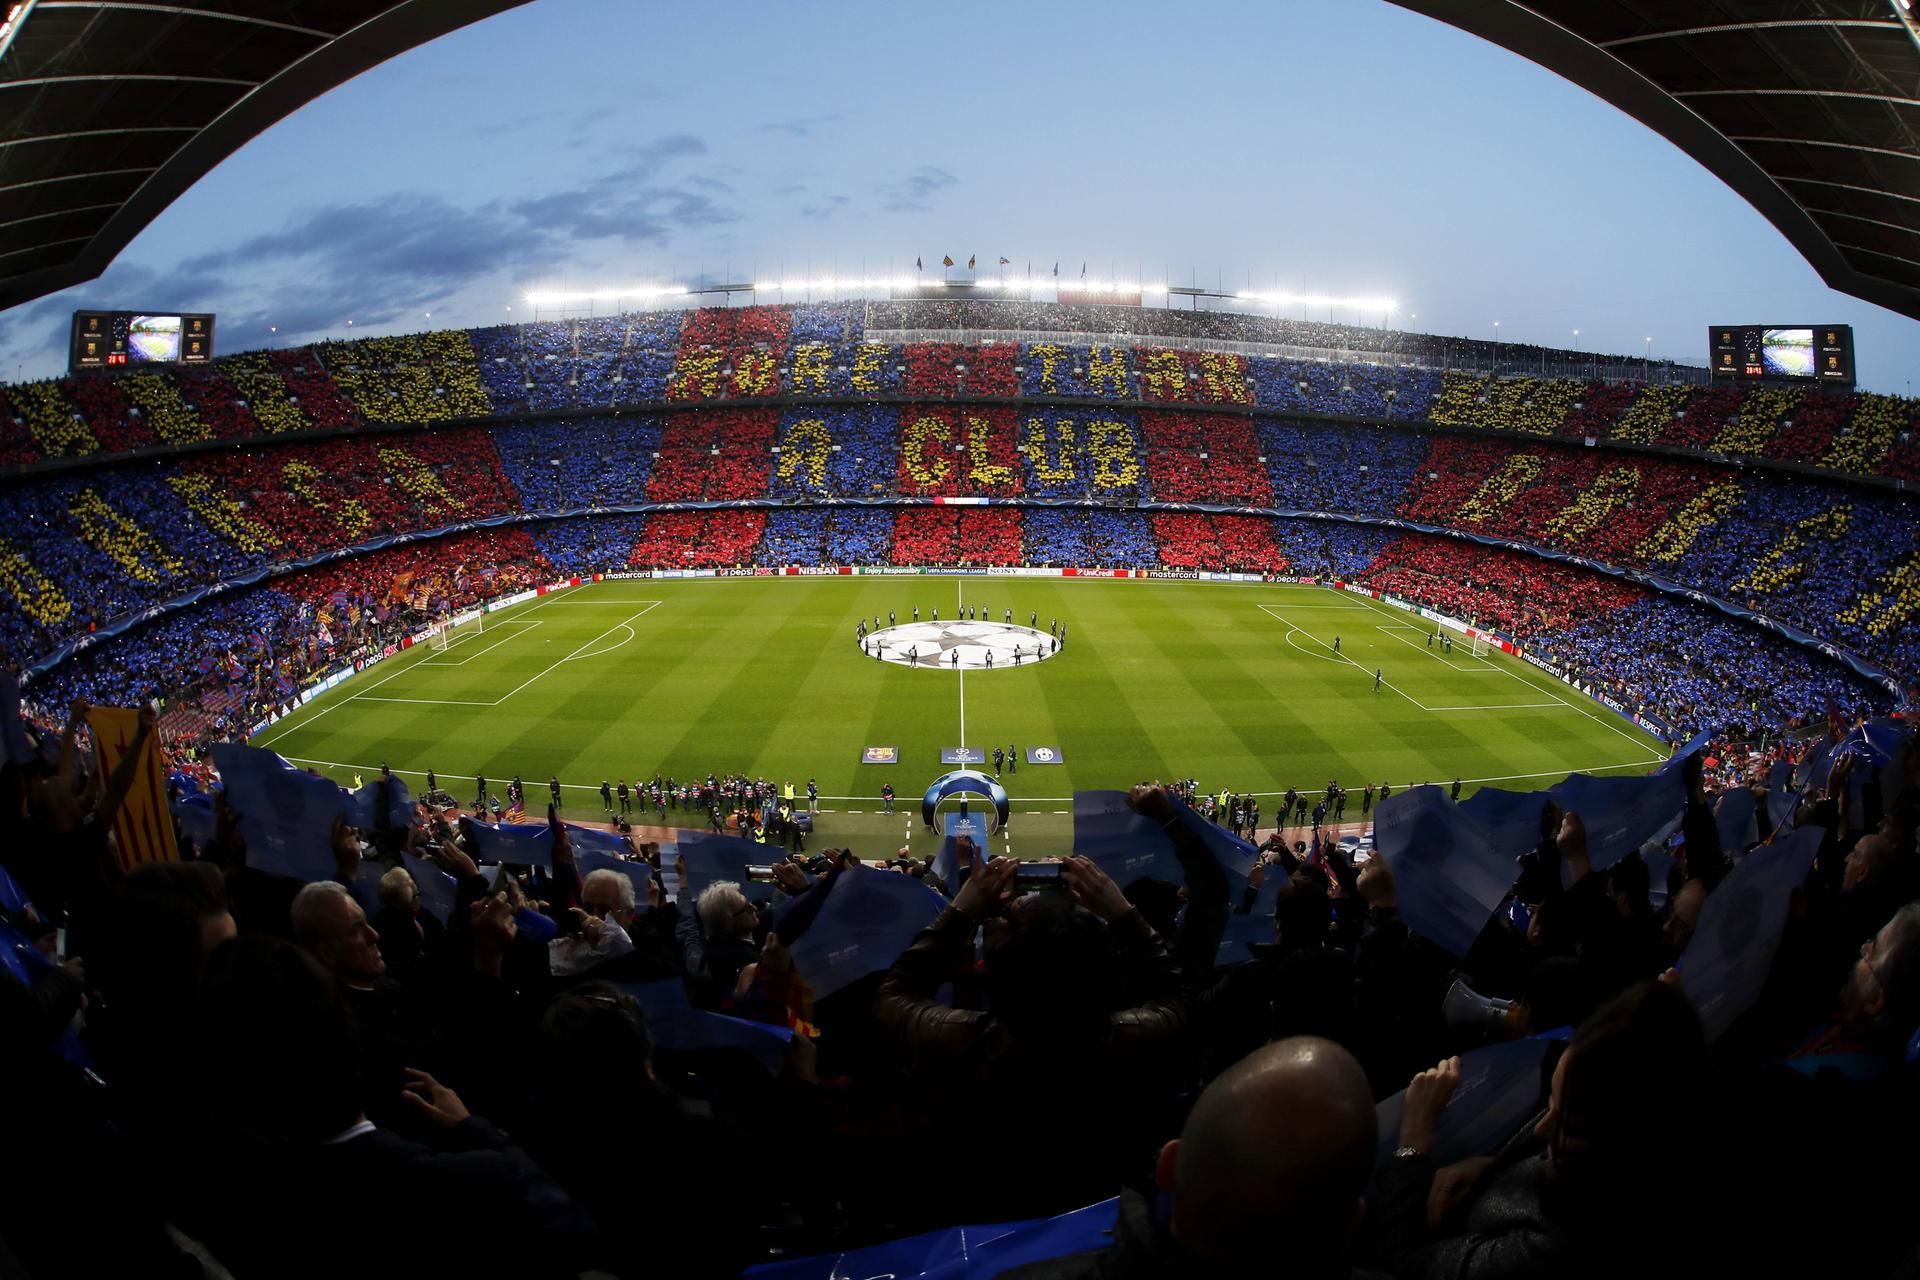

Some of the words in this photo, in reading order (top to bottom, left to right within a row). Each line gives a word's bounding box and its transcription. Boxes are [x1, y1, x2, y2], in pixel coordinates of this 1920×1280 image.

[674, 343, 892, 399] MORE
[1028, 342, 1250, 404] THAN
[777, 418, 832, 487] A
[903, 416, 1141, 489] CLUB
[605, 571, 651, 580] mastercard
[730, 568, 753, 577] pepsi
[798, 567, 839, 575] NISSAN
[864, 567, 882, 576] Enjoy
[883, 567, 921, 576] Responsibly
[1150, 570, 1198, 579] mastercard
[1276, 576, 1298, 584] pepsi
[1344, 584, 1373, 597] NISSAN
[411, 625, 441, 644] NISSAN
[365, 652, 384, 668] pepsi
[1522, 652, 1561, 677] mastercard
[1604, 696, 1625, 713] RESPECT
[1639, 717, 1662, 737] RESPECT
